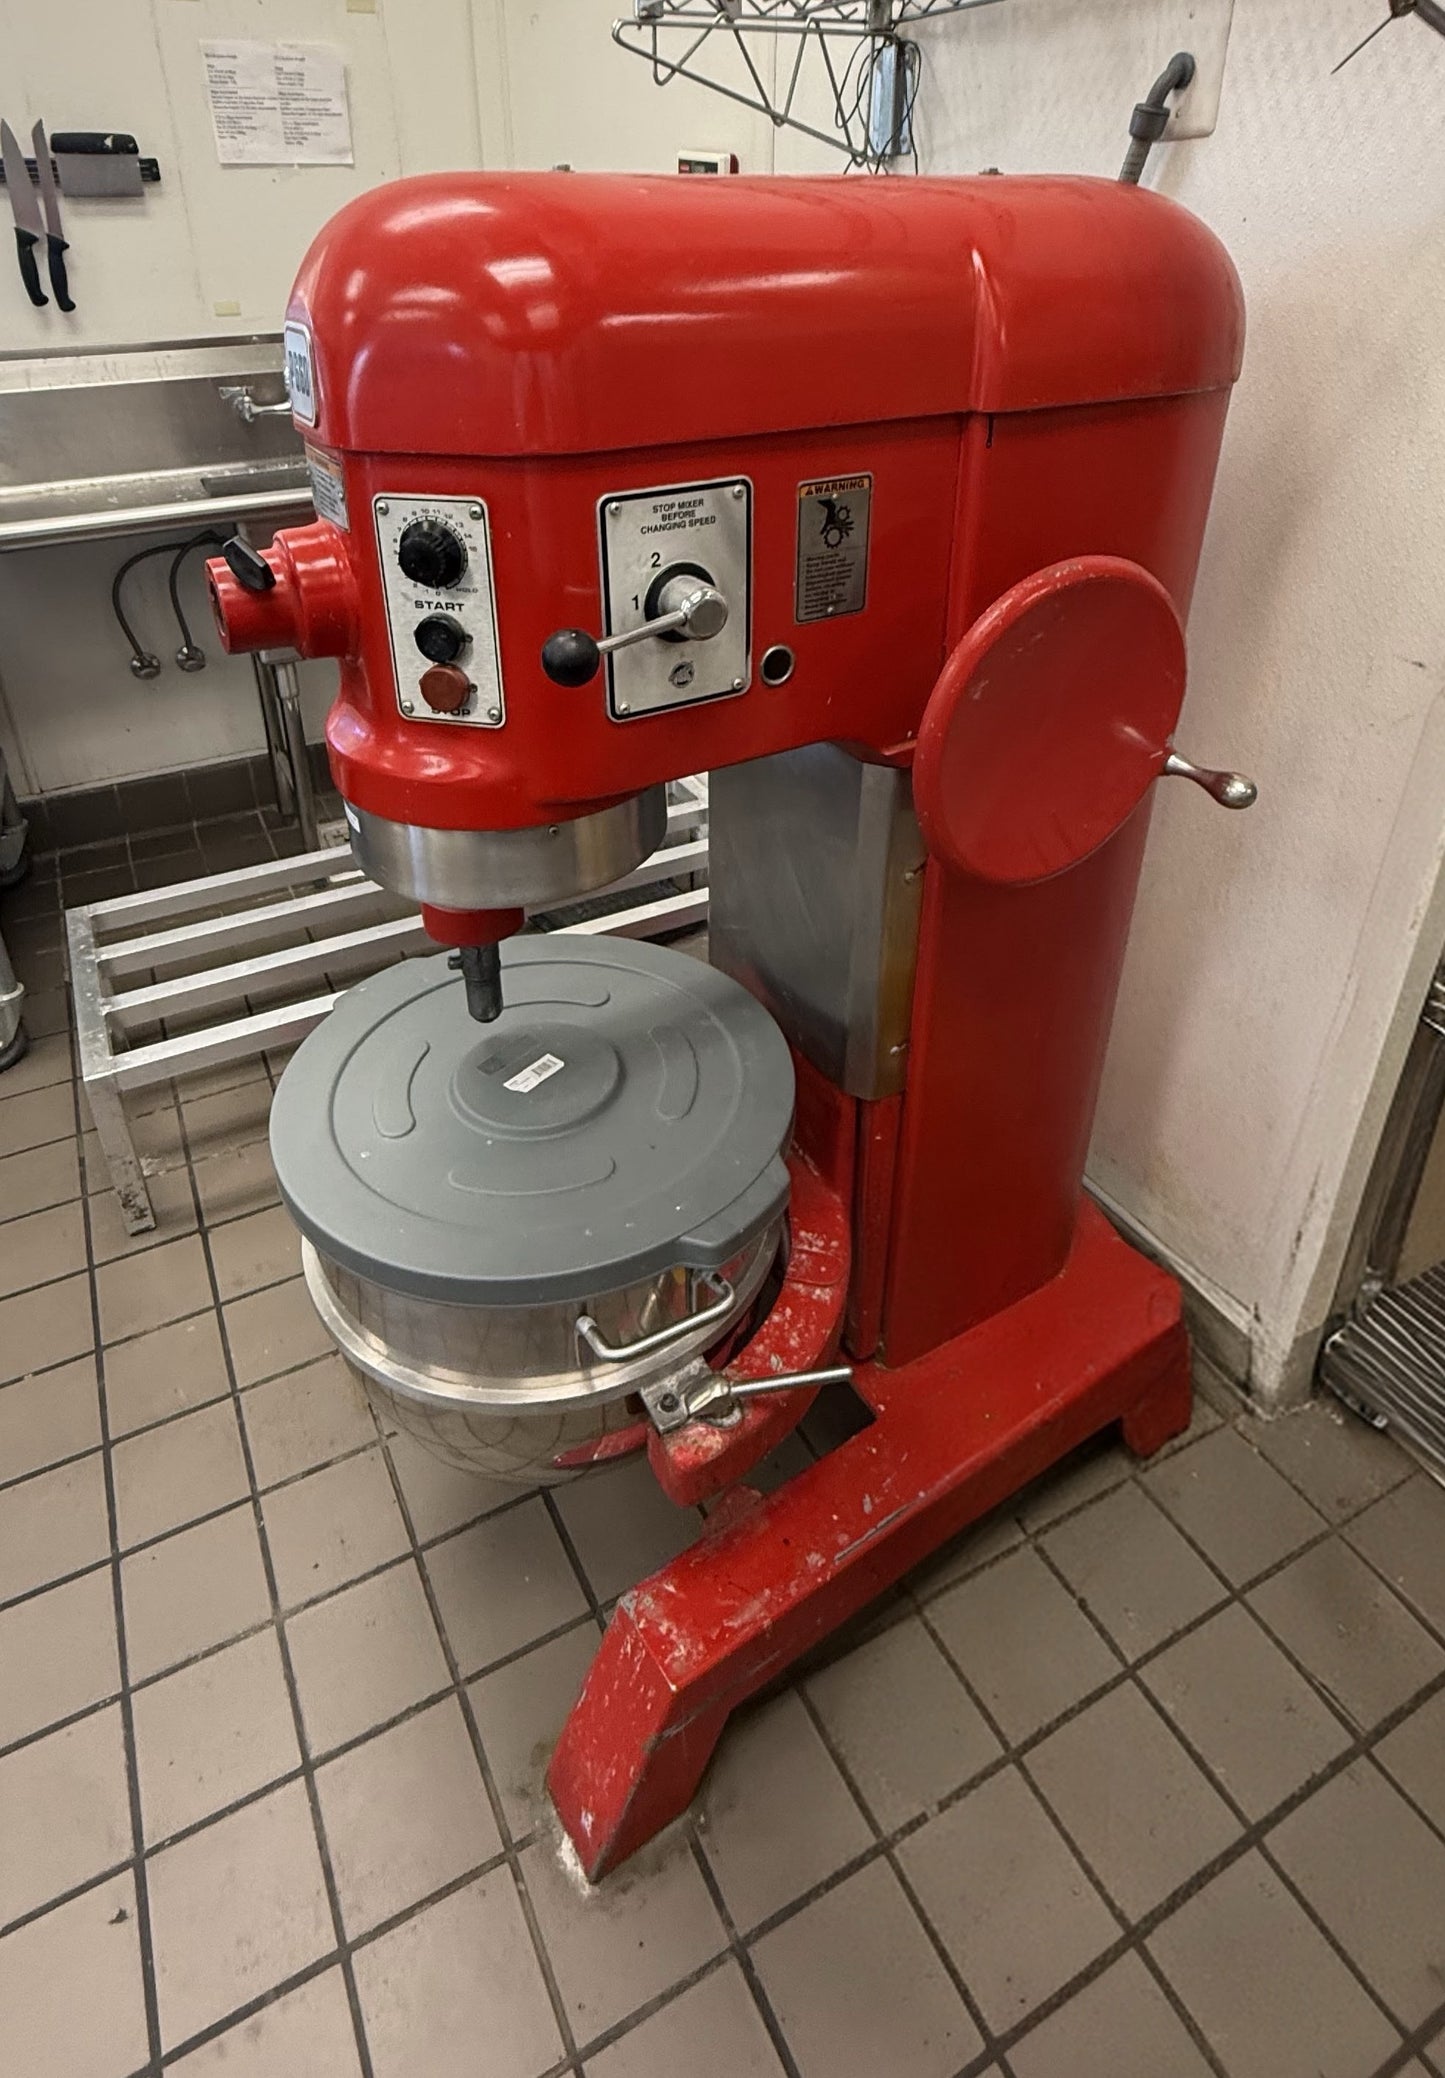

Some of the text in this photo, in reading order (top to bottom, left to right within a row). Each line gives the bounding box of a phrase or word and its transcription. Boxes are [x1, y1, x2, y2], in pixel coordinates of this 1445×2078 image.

[814, 480, 865, 494] WARNING
[652, 499, 704, 513] STOP MIXER
[661, 510, 696, 521] BEFORE
[640, 516, 716, 534] CHANGING SPEED
[651, 552, 661, 568] 2
[414, 600, 465, 612] START
[631, 594, 639, 610] 1
